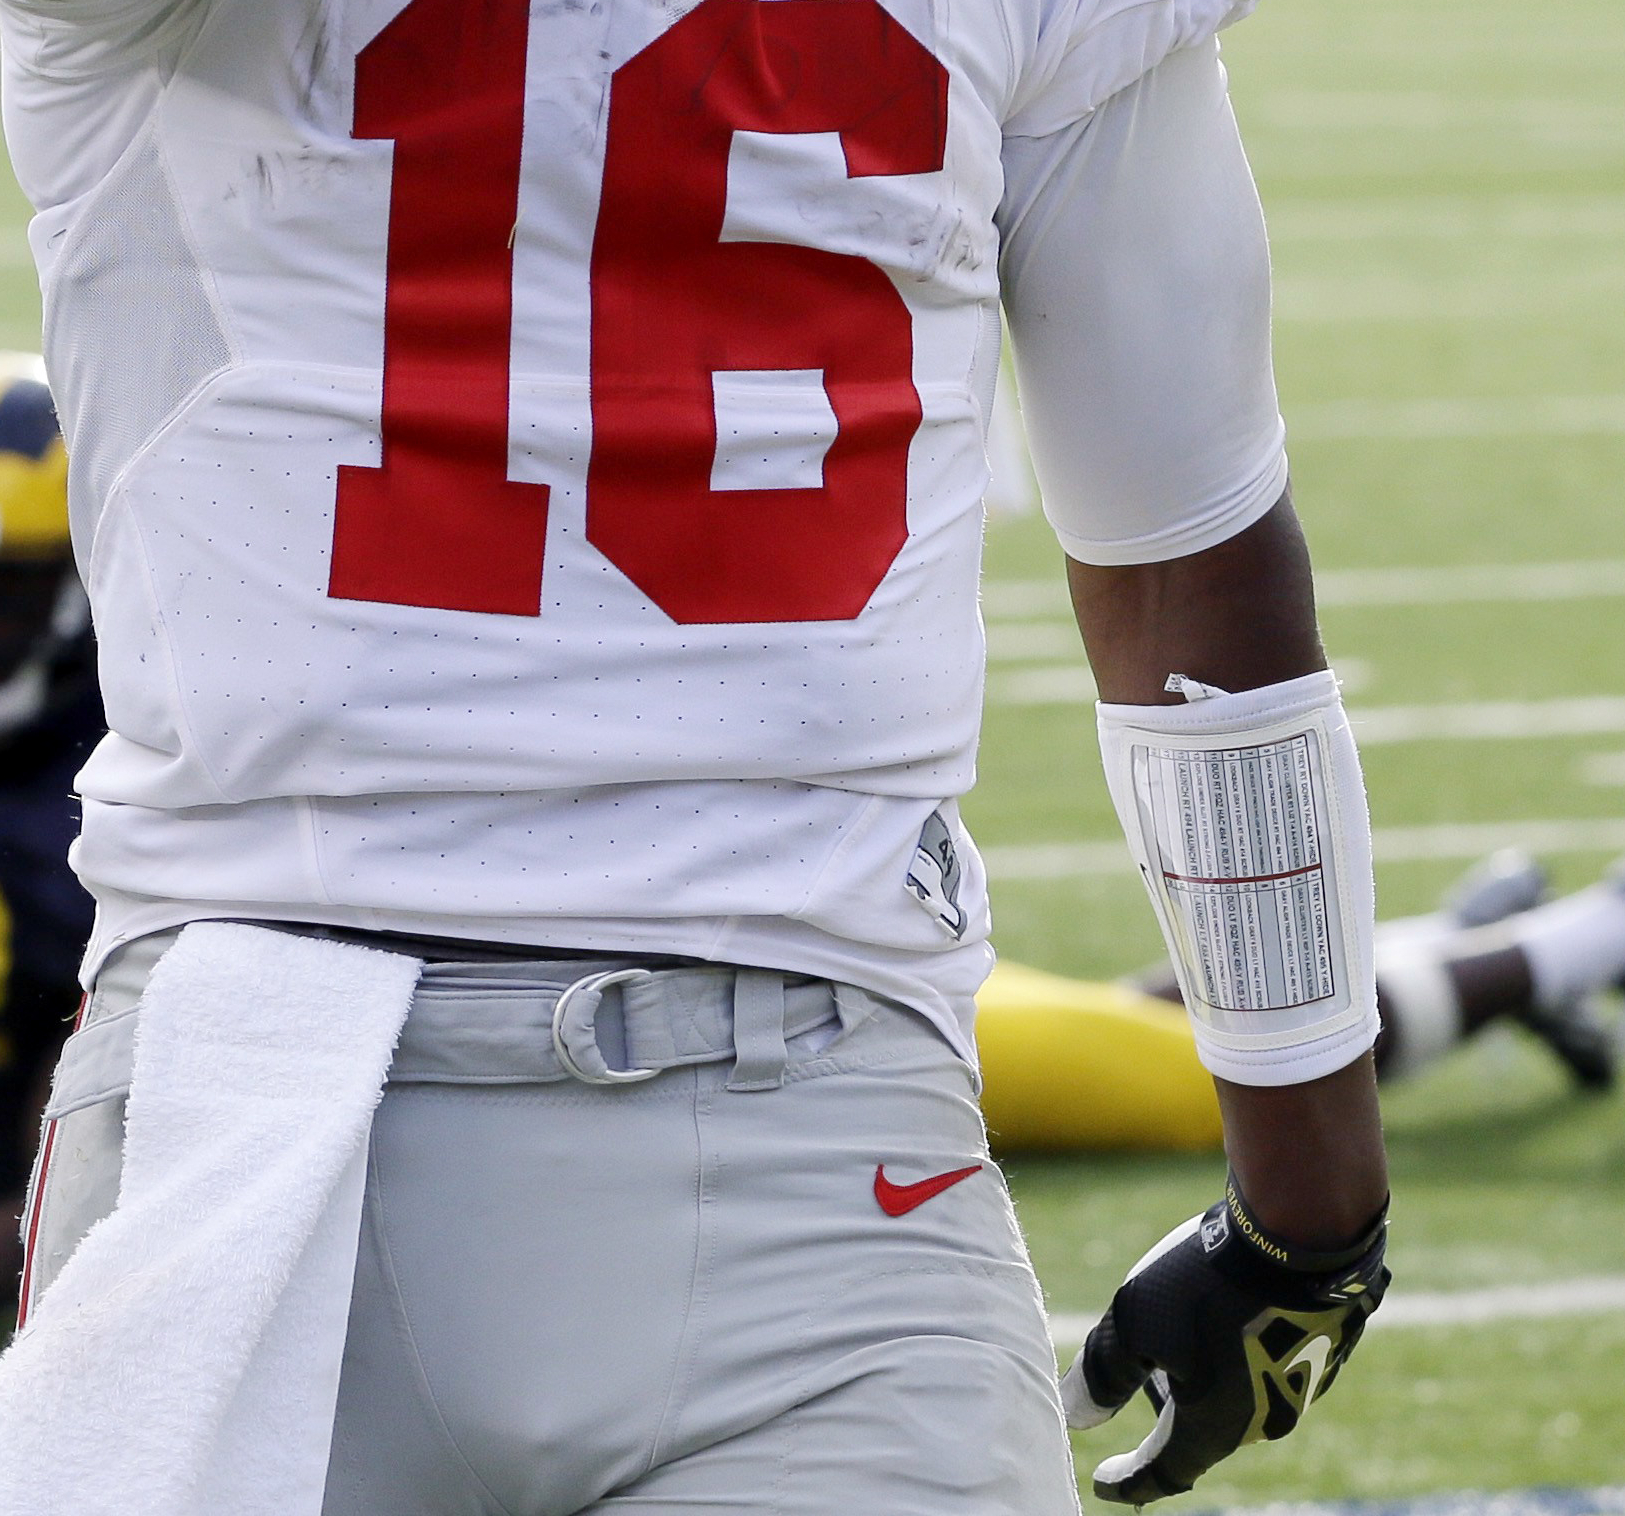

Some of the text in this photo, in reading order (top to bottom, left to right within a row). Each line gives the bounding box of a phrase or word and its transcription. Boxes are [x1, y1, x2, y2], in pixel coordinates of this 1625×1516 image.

[1296, 749, 1306, 769] TREY
[1211, 762, 1220, 779] DUO
[1216, 809, 1225, 825] HAC
[1300, 783, 1310, 806] DOWN
[1178, 762, 1189, 797] LAUNCH
[1185, 828, 1197, 863] LAUNCH
[1303, 808, 1312, 823] YAC
[1311, 883, 1320, 901] TREY
[1226, 895, 1235, 911] DUO
[1231, 940, 1240, 956] HAC
[1314, 914, 1324, 937] DOWN
[1194, 895, 1205, 930] LAUNCH
[1203, 959, 1215, 993] LAUNCH
[1317, 940, 1326, 954] YAC
